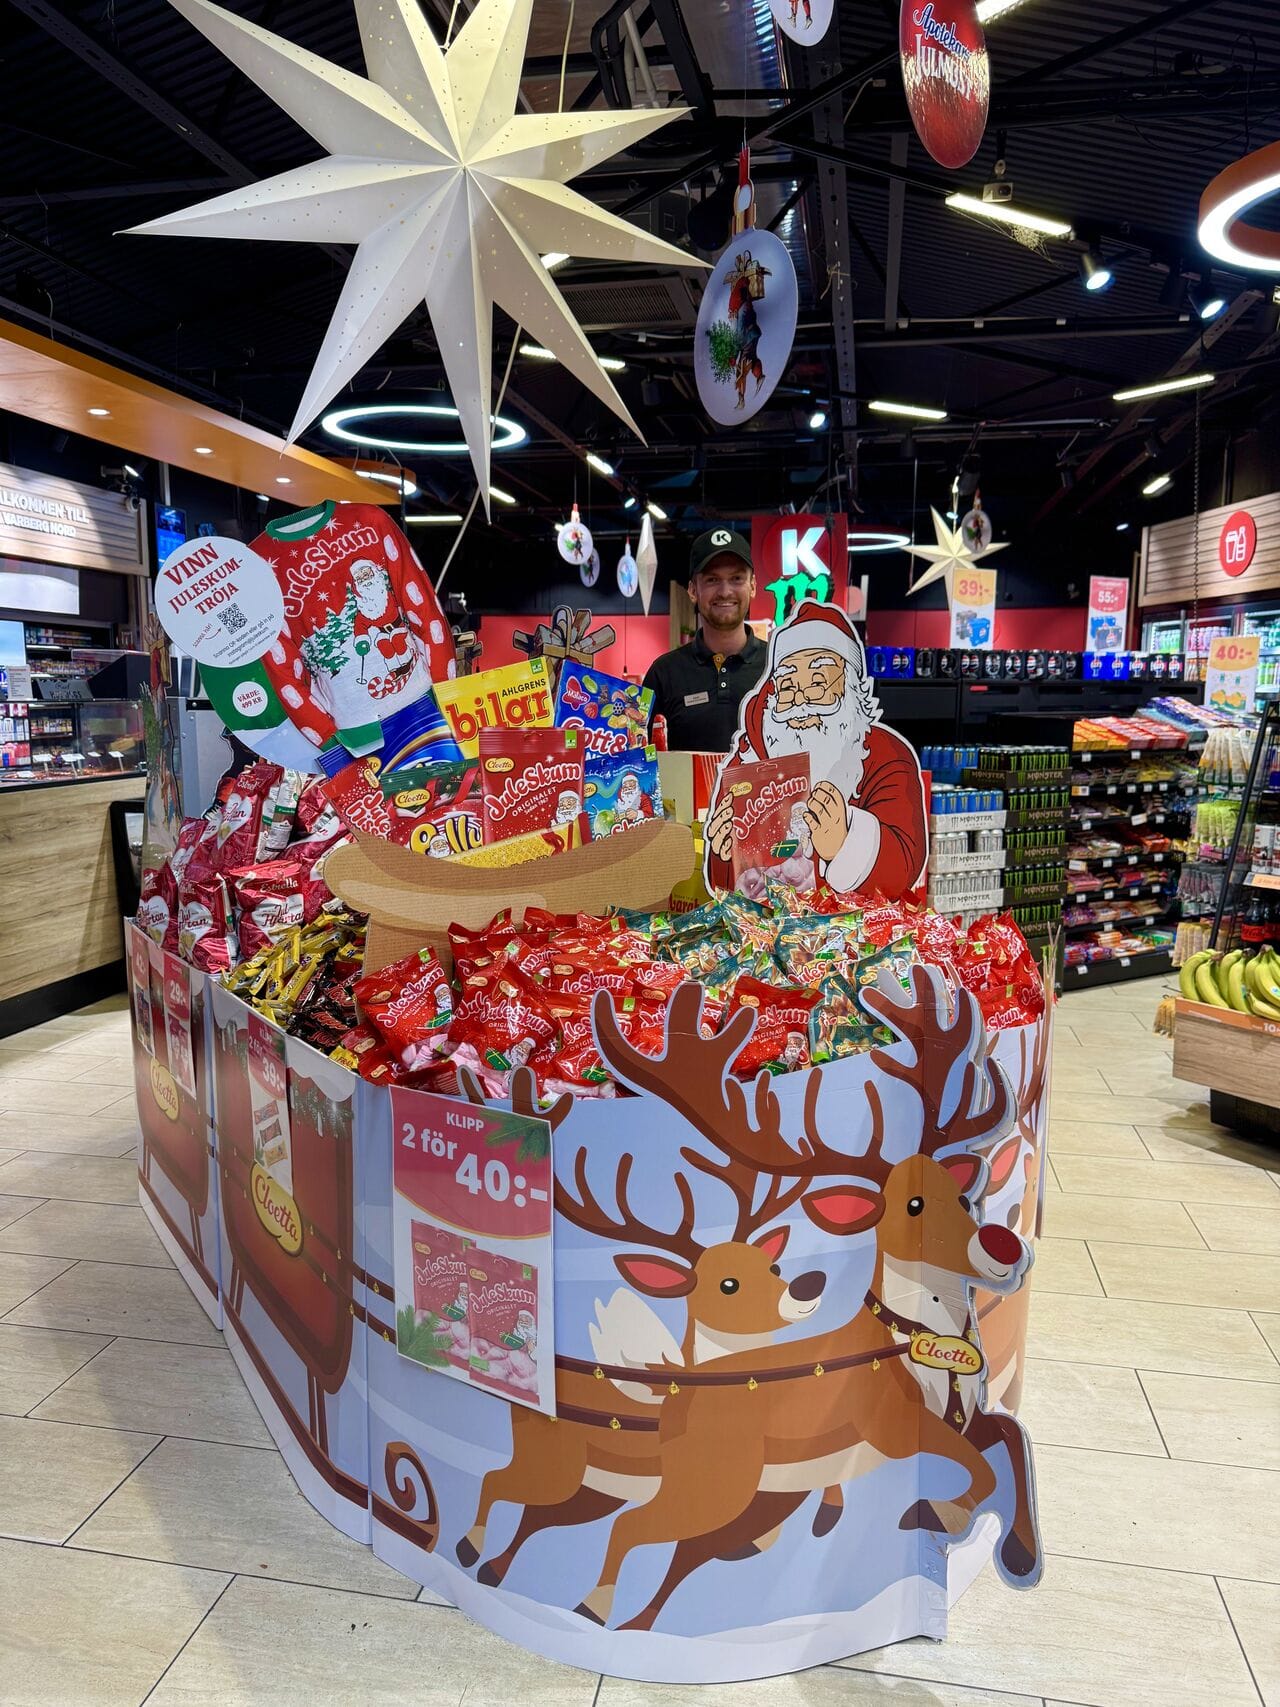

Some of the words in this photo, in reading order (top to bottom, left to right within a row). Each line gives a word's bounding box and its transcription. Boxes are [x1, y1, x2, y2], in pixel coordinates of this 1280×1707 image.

[2, 511, 49, 533] VARBERG
[50, 521, 76, 537] NORD
[65, 505, 89, 523] TILL
[716, 533, 729, 545] K
[781, 526, 830, 578] K
[163, 542, 219, 586] VINN
[283, 526, 379, 618] JuleSkum
[167, 557, 243, 615] JULESKUM-
[958, 579, 990, 596] 39:-
[1097, 590, 1119, 603] 55:-
[194, 582, 240, 615] TRÖJA
[1215, 644, 1253, 660] 40:-
[237, 689, 260, 702] VÄRDE:
[501, 678, 546, 698] AHLGRENS
[445, 689, 549, 744] bilar
[487, 760, 512, 769] Cloetta
[1027, 771, 1064, 780] MONSTER
[396, 792, 429, 804] Cloetta
[483, 762, 582, 821] JuleSkum
[511, 786, 557, 816] ORIGINALET
[731, 776, 808, 840] JuleSkum
[960, 815, 993, 823] MONSTER
[1028, 810, 1064, 819] MONSTER
[959, 854, 992, 862] MONSTER
[1024, 847, 1060, 857] MONSTER
[957, 894, 991, 902] MONSTER
[1023, 884, 1060, 894] MONSTER
[376, 967, 445, 1028] JuleSkum
[480, 999, 554, 1037] JuleSkum
[248, 1035, 254, 1049] 2
[262, 1056, 285, 1092] 39:-
[446, 1111, 485, 1132] KLIPP
[401, 1122, 416, 1149] 2
[421, 1128, 458, 1160] för
[455, 1152, 548, 1208] 40:-
[255, 1174, 298, 1242] Cloetta
[469, 1282, 536, 1313] JuleSkum
[915, 1338, 976, 1366] Cloetta
